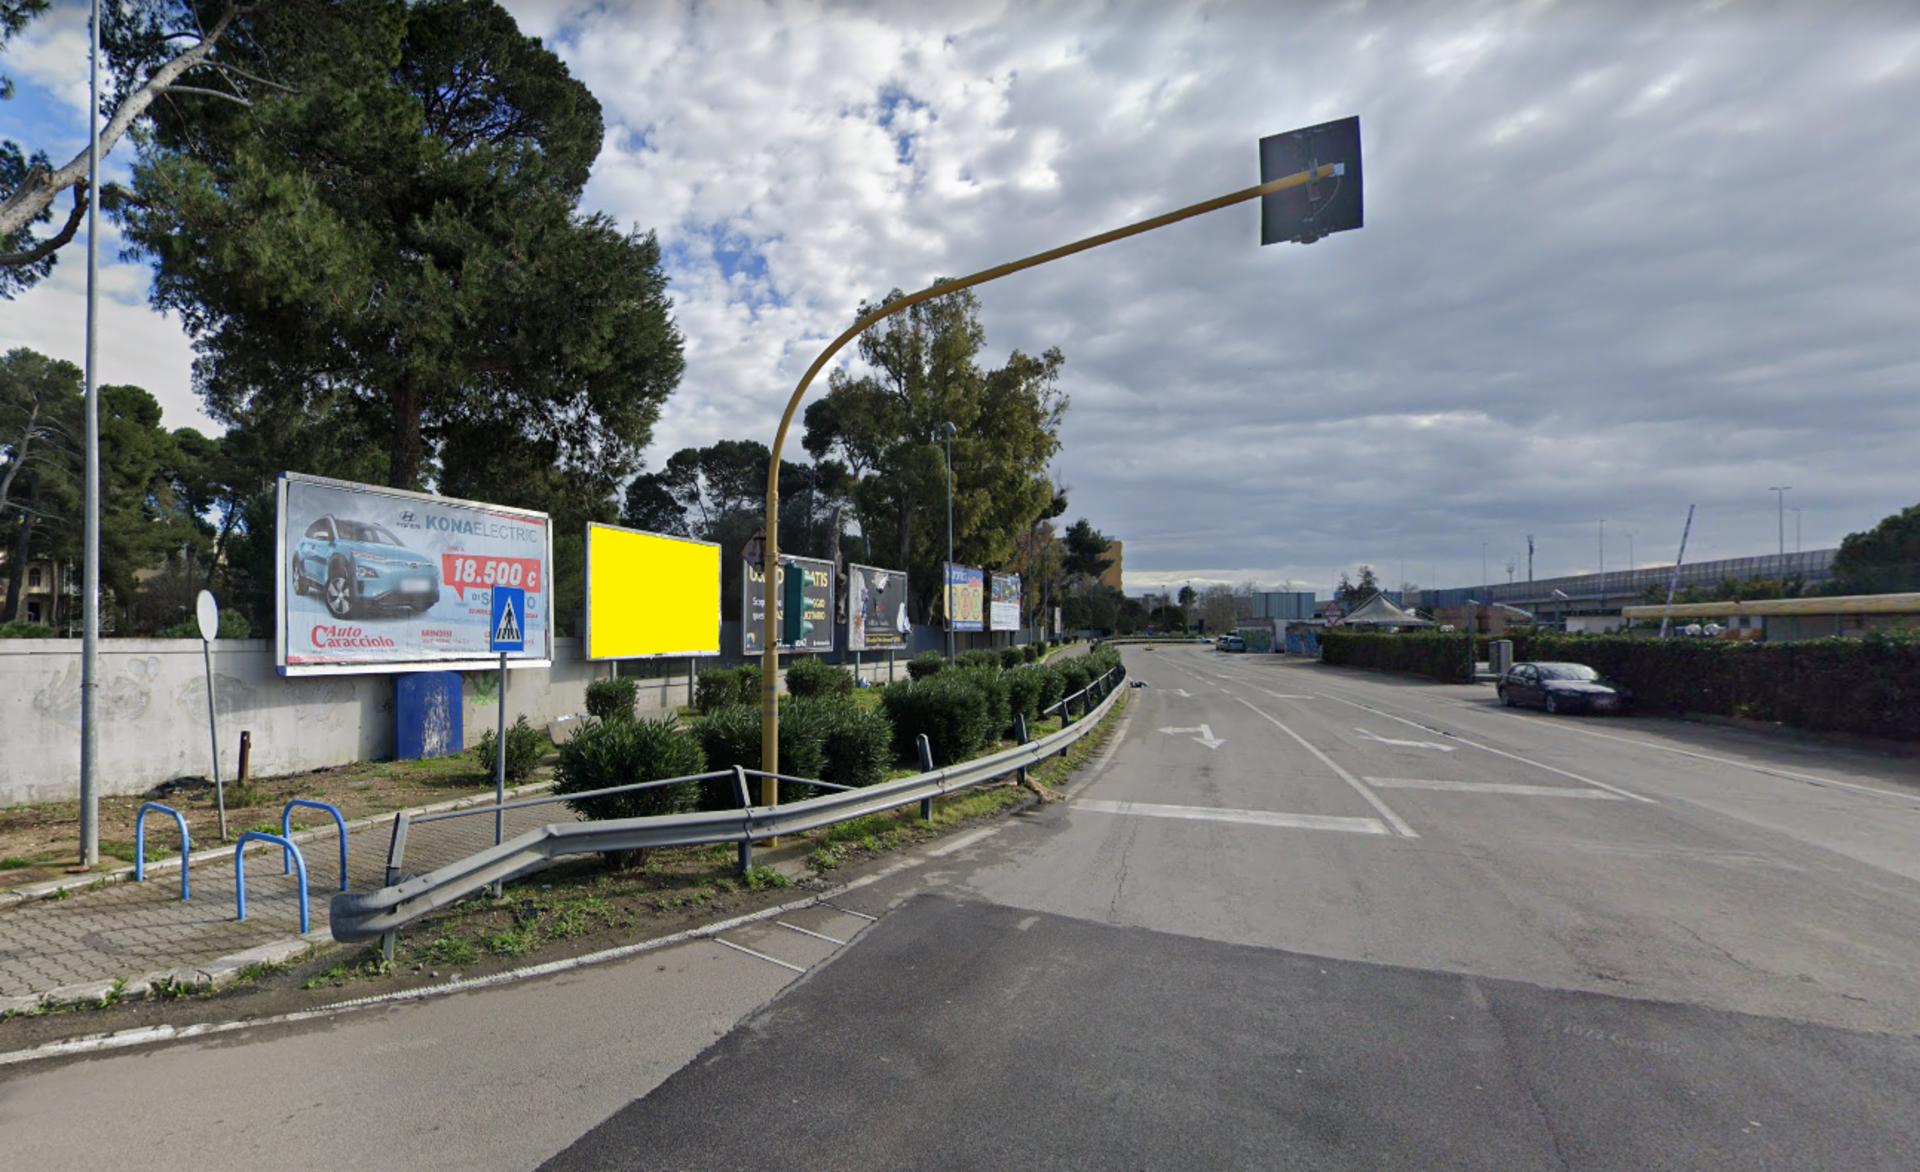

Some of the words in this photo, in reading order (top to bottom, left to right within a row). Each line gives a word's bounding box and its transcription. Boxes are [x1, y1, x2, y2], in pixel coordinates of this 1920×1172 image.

[454, 558, 522, 586] 18.500
[311, 624, 395, 649] Caracciolo
[325, 625, 362, 638] Auto
